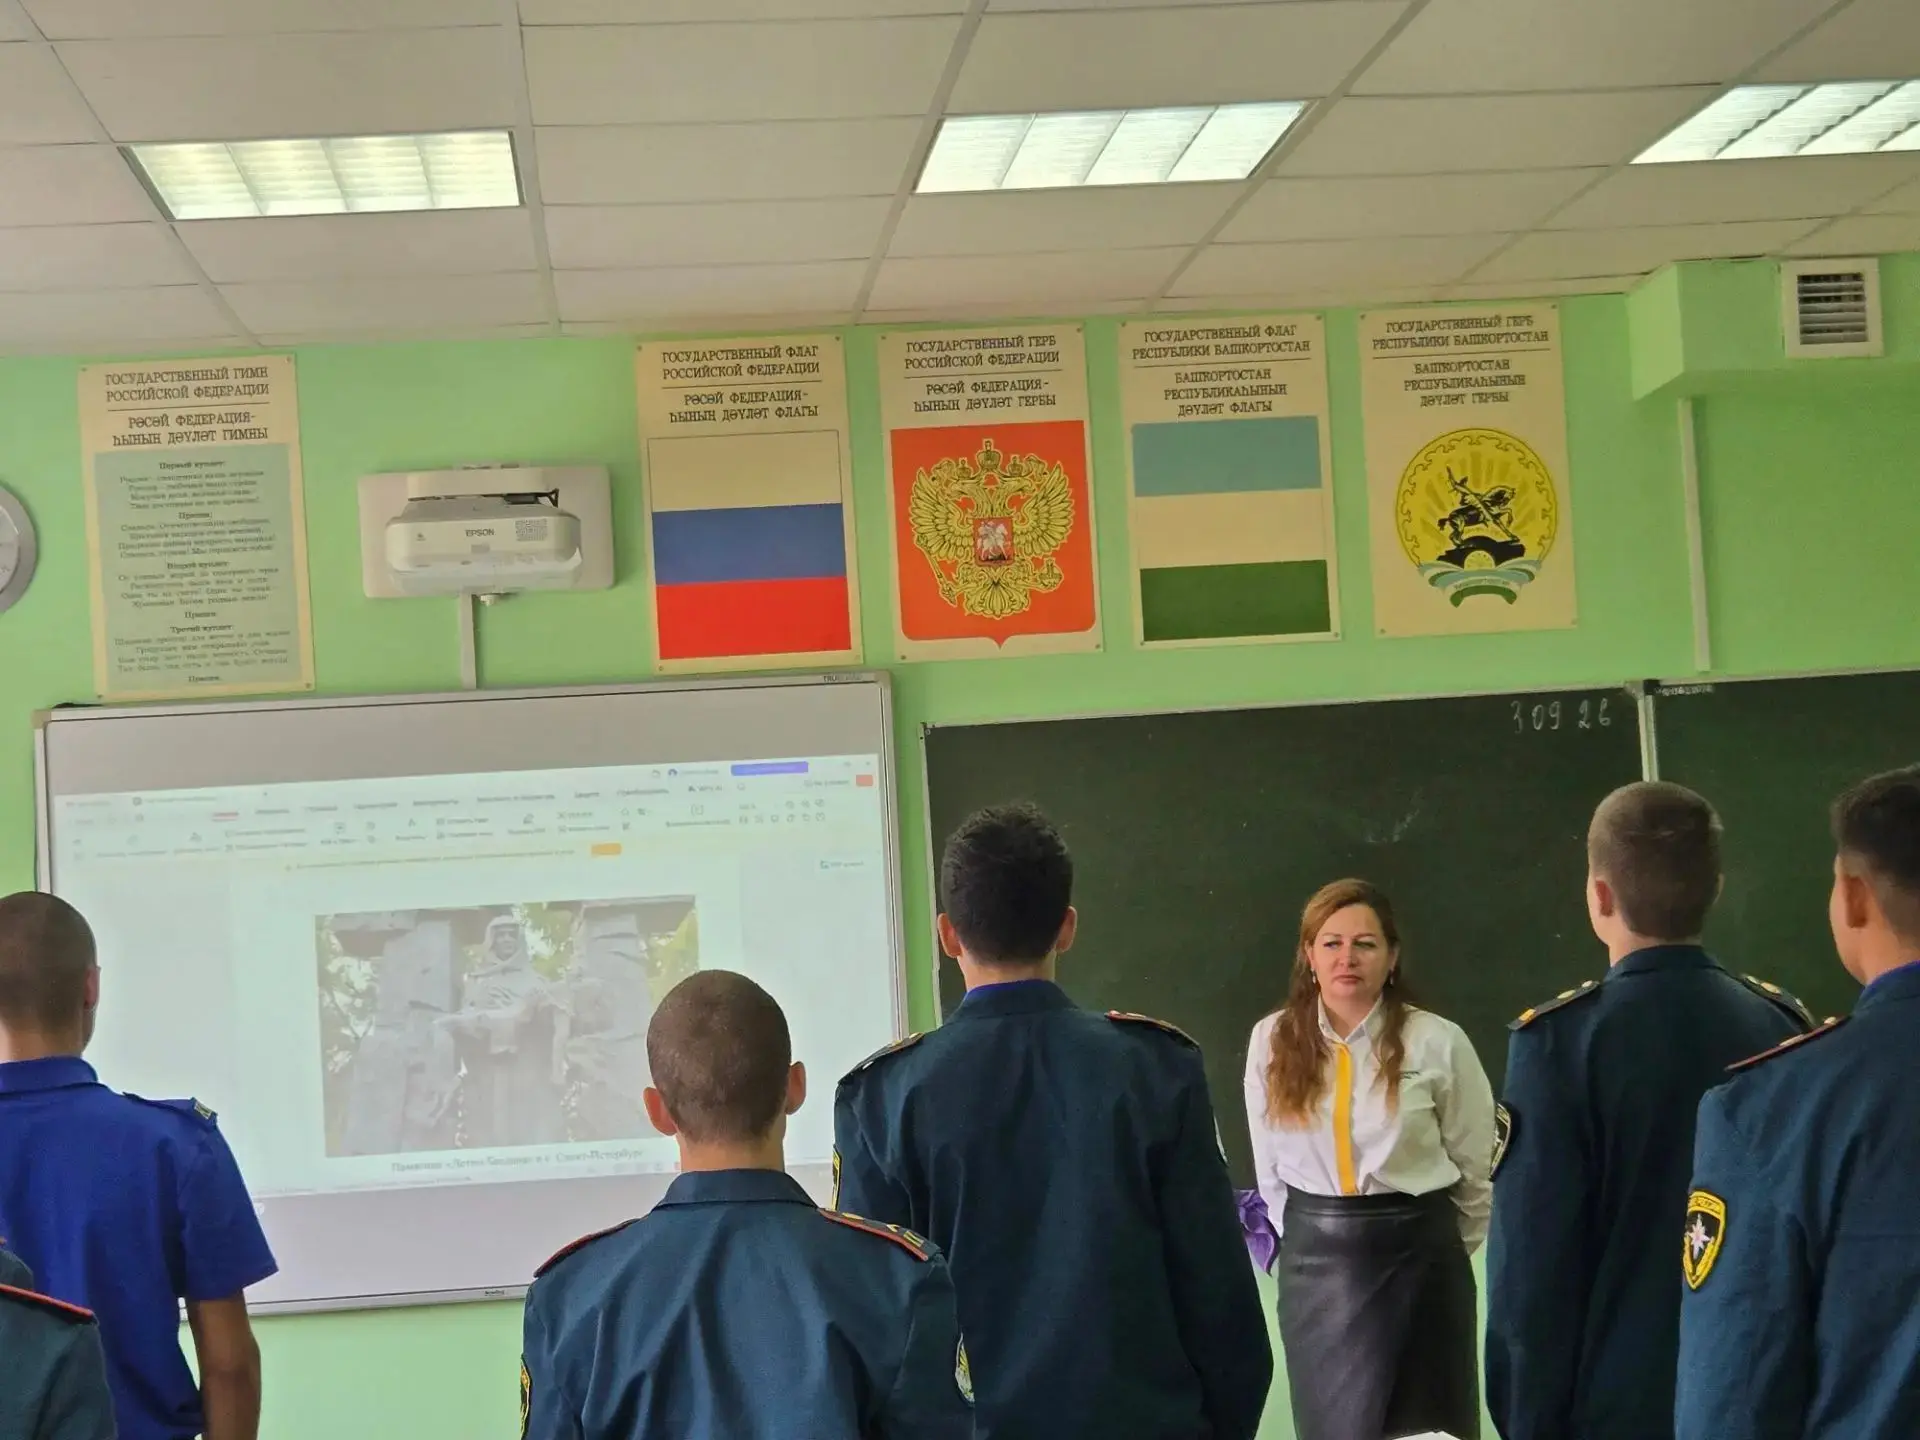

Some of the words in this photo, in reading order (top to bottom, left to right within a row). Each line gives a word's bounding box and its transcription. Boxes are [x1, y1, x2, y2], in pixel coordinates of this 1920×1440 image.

[1386, 314, 1502, 334] ГОСУДАРСТВЕННЫЙ
[1506, 315, 1534, 327] ГЕРБ
[1144, 324, 1260, 343] ГОСУДАРСТВЕННЫЙ
[1265, 324, 1296, 337] ФЛАГ
[1372, 334, 1449, 350] РЕСПУБЛИКИ
[1454, 331, 1549, 346] БАШКОРТОСТАН
[906, 335, 1024, 353] ГОСУДАРСТВЕННЫЙ
[1028, 335, 1056, 347] ГЕРБ
[1132, 344, 1210, 360] РЕСПУБЛИКИ
[1214, 340, 1310, 356] БАШКОРТОСТАН
[662, 344, 781, 364] ГОСУДАРСТВЕННЫЙ
[786, 345, 819, 358] ФЛАГ
[905, 352, 983, 369] РОССИЙСКОЙ
[988, 351, 1060, 366] ФЕДЕРАЦИИ
[105, 366, 229, 386] ГОСУДАРСТВЕННЫЙ
[233, 366, 269, 379] ГИМН
[663, 363, 743, 380] РОССИЙСКОЙ
[747, 361, 820, 376] ФЕДЕРАЦИИ
[106, 385, 189, 402] РОССИЙСКОЙ
[194, 383, 269, 398] ФЕДЕРАЦИИ
[971, 378, 1049, 394] ФЕДЕРАЦИЯ-
[729, 389, 808, 405] ФЕДЕРАЦИЯ-
[1018, 394, 1056, 407] ГЕРБЫ
[1472, 391, 1510, 404] ГЕРБЫ
[775, 405, 818, 419] ФЛАГЫ
[1229, 400, 1273, 414] ФЛАГЫ
[175, 411, 256, 427] ФЕДЕРАЦИЯ-
[223, 427, 268, 441] ГИМНЫ
[465, 528, 495, 538] EPSON
